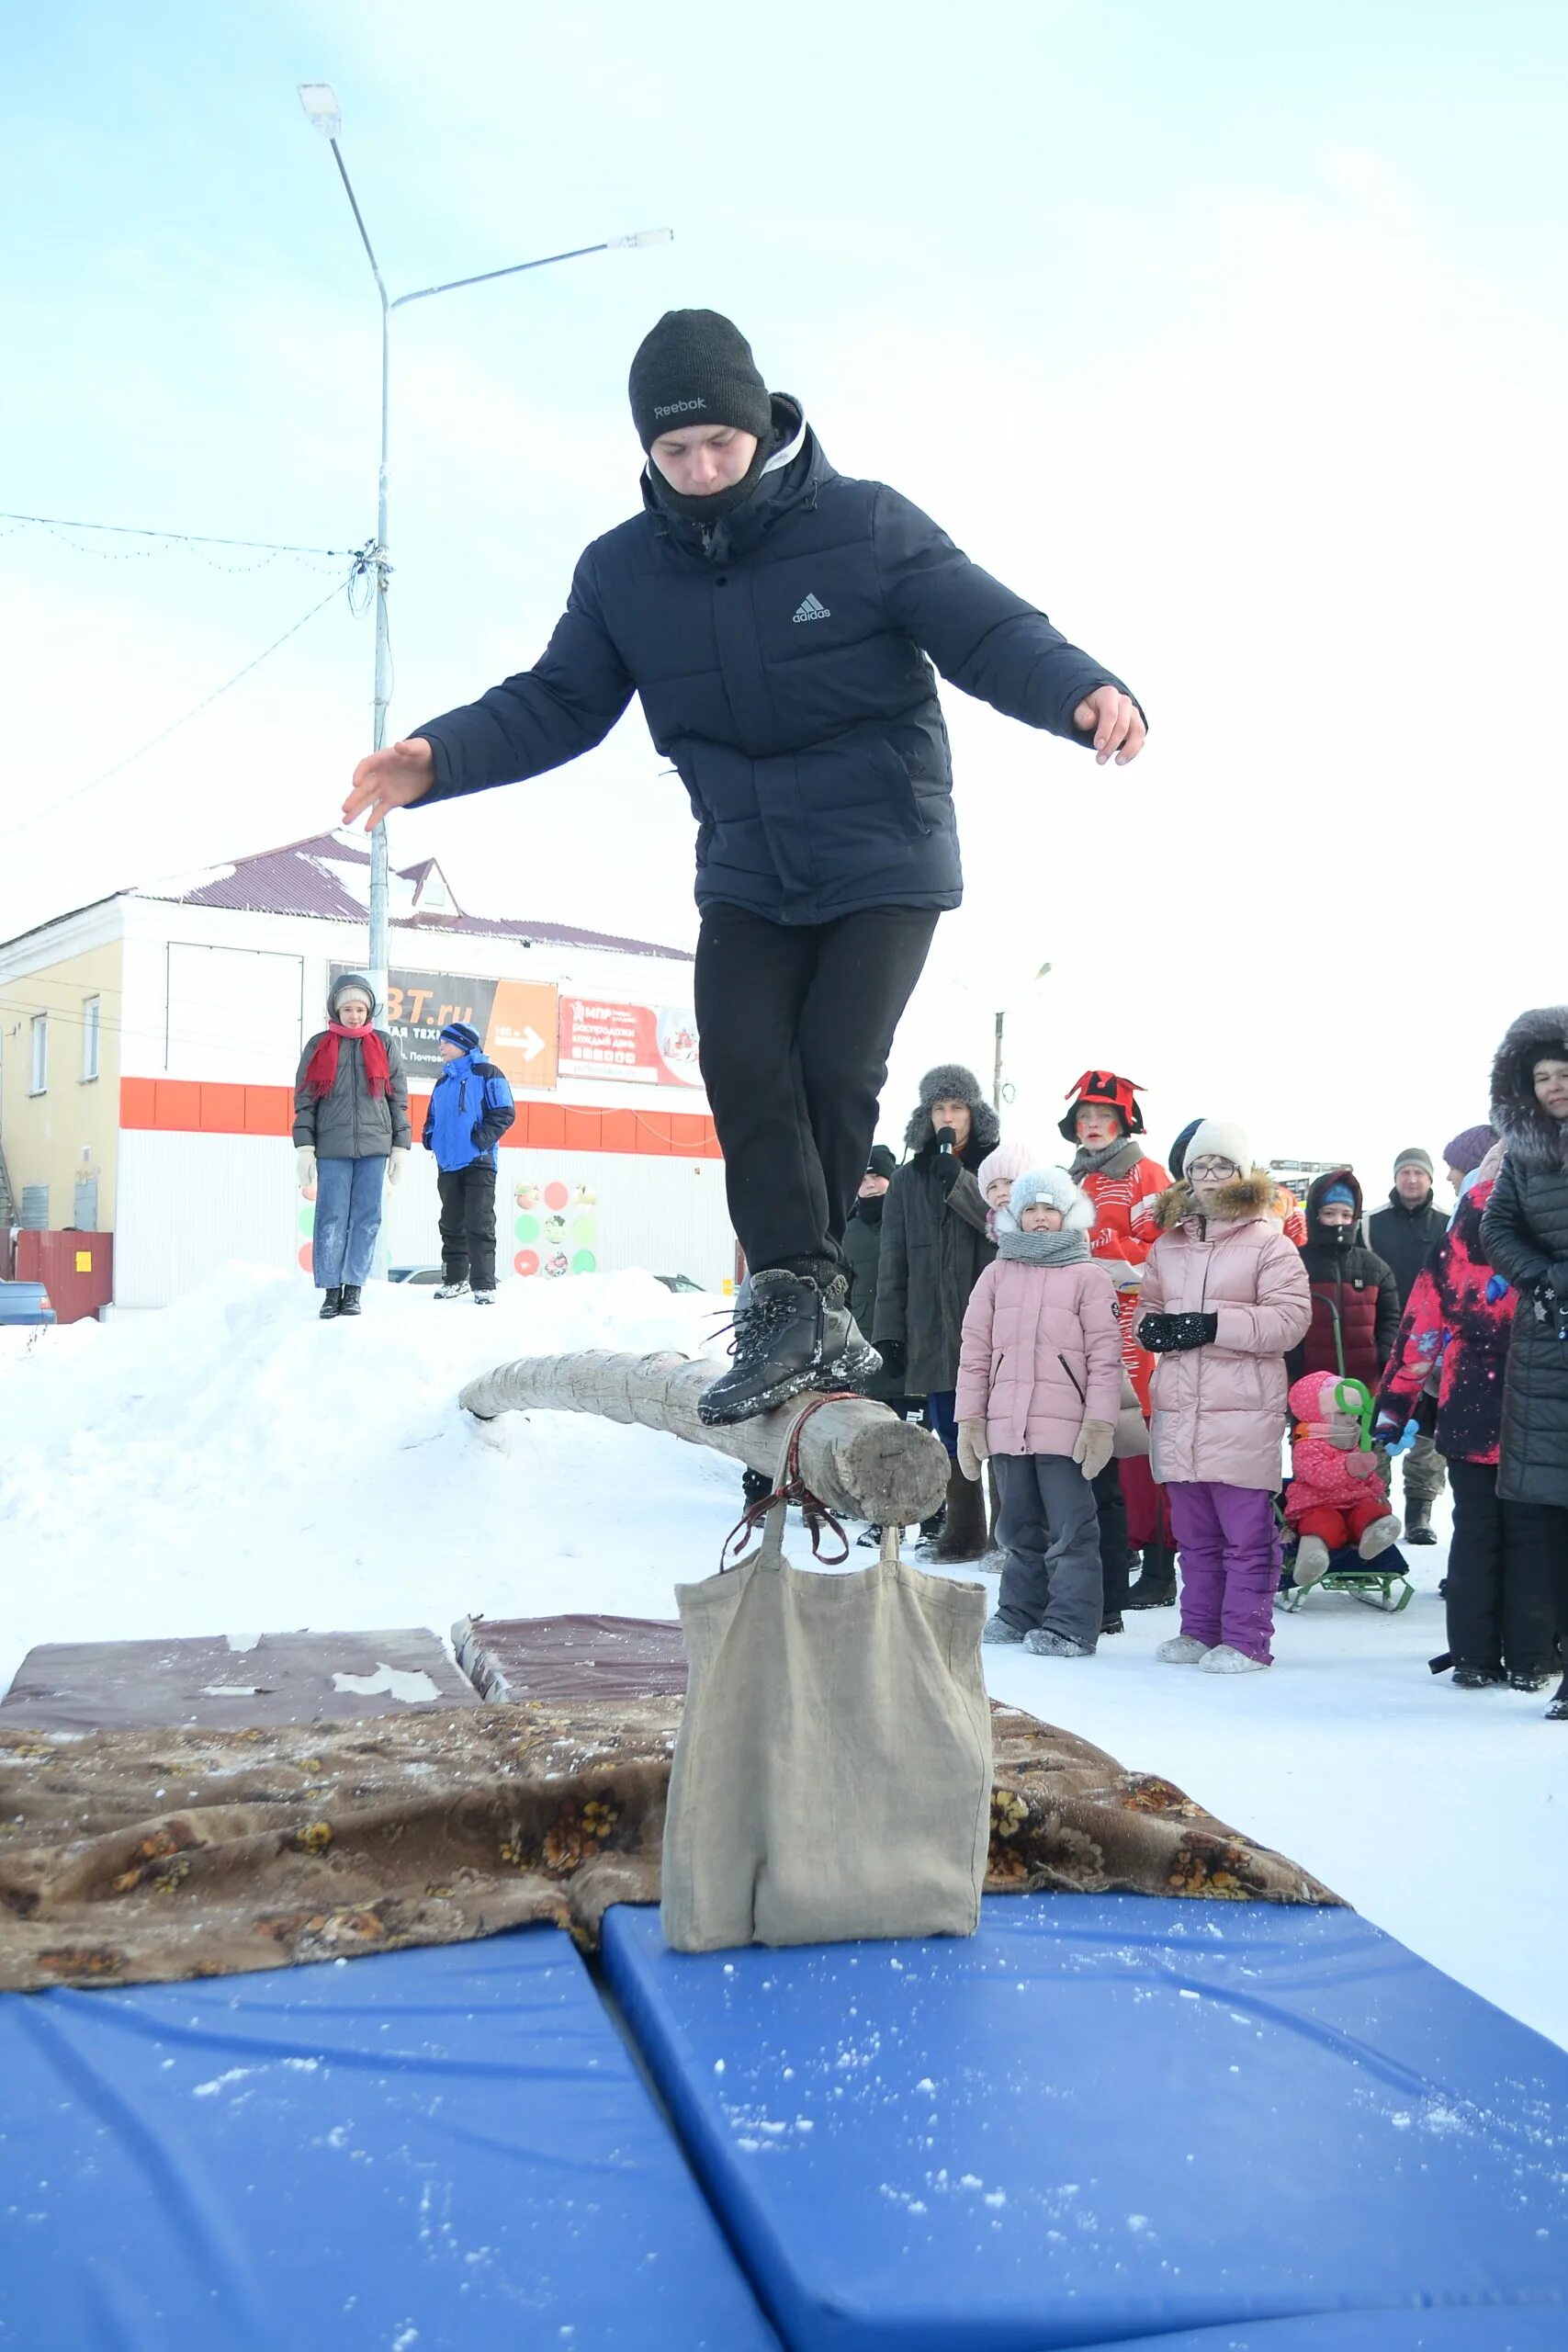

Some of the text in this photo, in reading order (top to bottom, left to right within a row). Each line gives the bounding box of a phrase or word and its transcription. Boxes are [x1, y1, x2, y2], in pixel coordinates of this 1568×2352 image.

[654, 397, 706, 419] Reebok
[793, 608, 831, 623] adidas
[387, 1025, 409, 1037] АЯ
